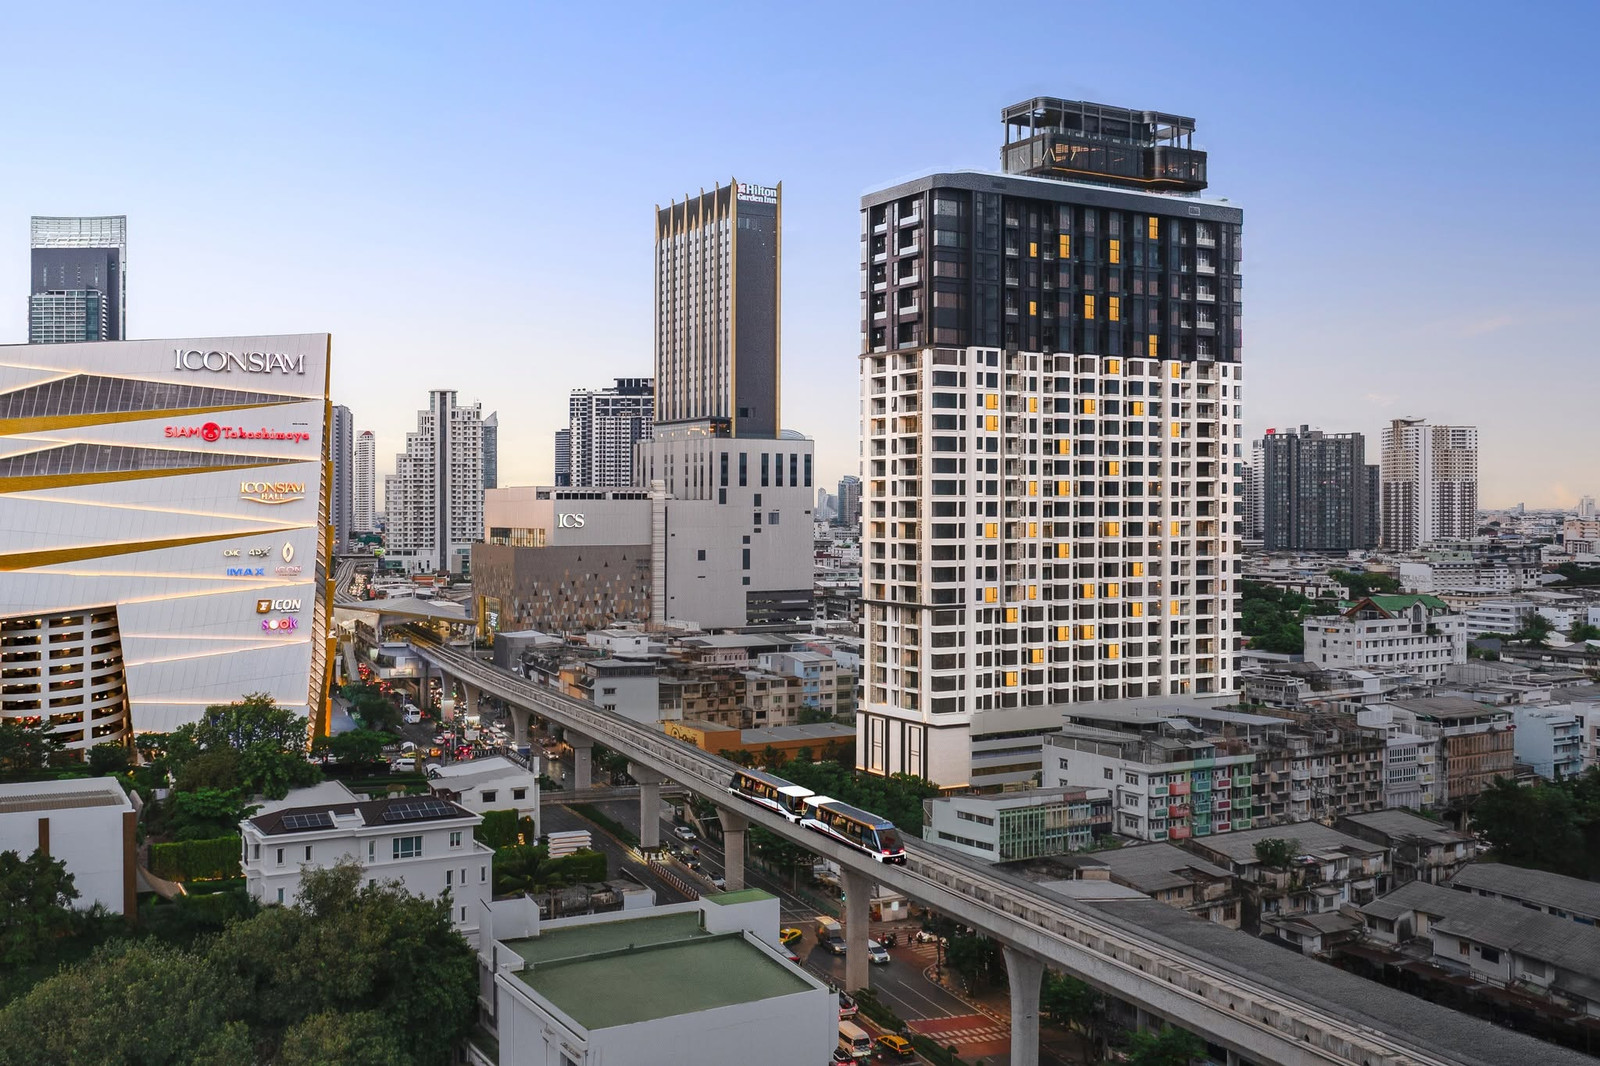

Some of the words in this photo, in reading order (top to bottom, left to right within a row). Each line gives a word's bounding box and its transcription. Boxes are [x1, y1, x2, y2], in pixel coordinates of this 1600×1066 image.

[747, 184, 777, 197] Hilton
[737, 193, 763, 202] Garden
[764, 196, 777, 204] Inn
[174, 349, 306, 374] ICONSIAM
[164, 426, 200, 438] SIAM
[221, 426, 310, 443] Takashimaya
[240, 481, 305, 494] ICONSIAM
[558, 513, 585, 528] ICS
[227, 568, 264, 576] IMAX
[270, 599, 301, 610] ICON
